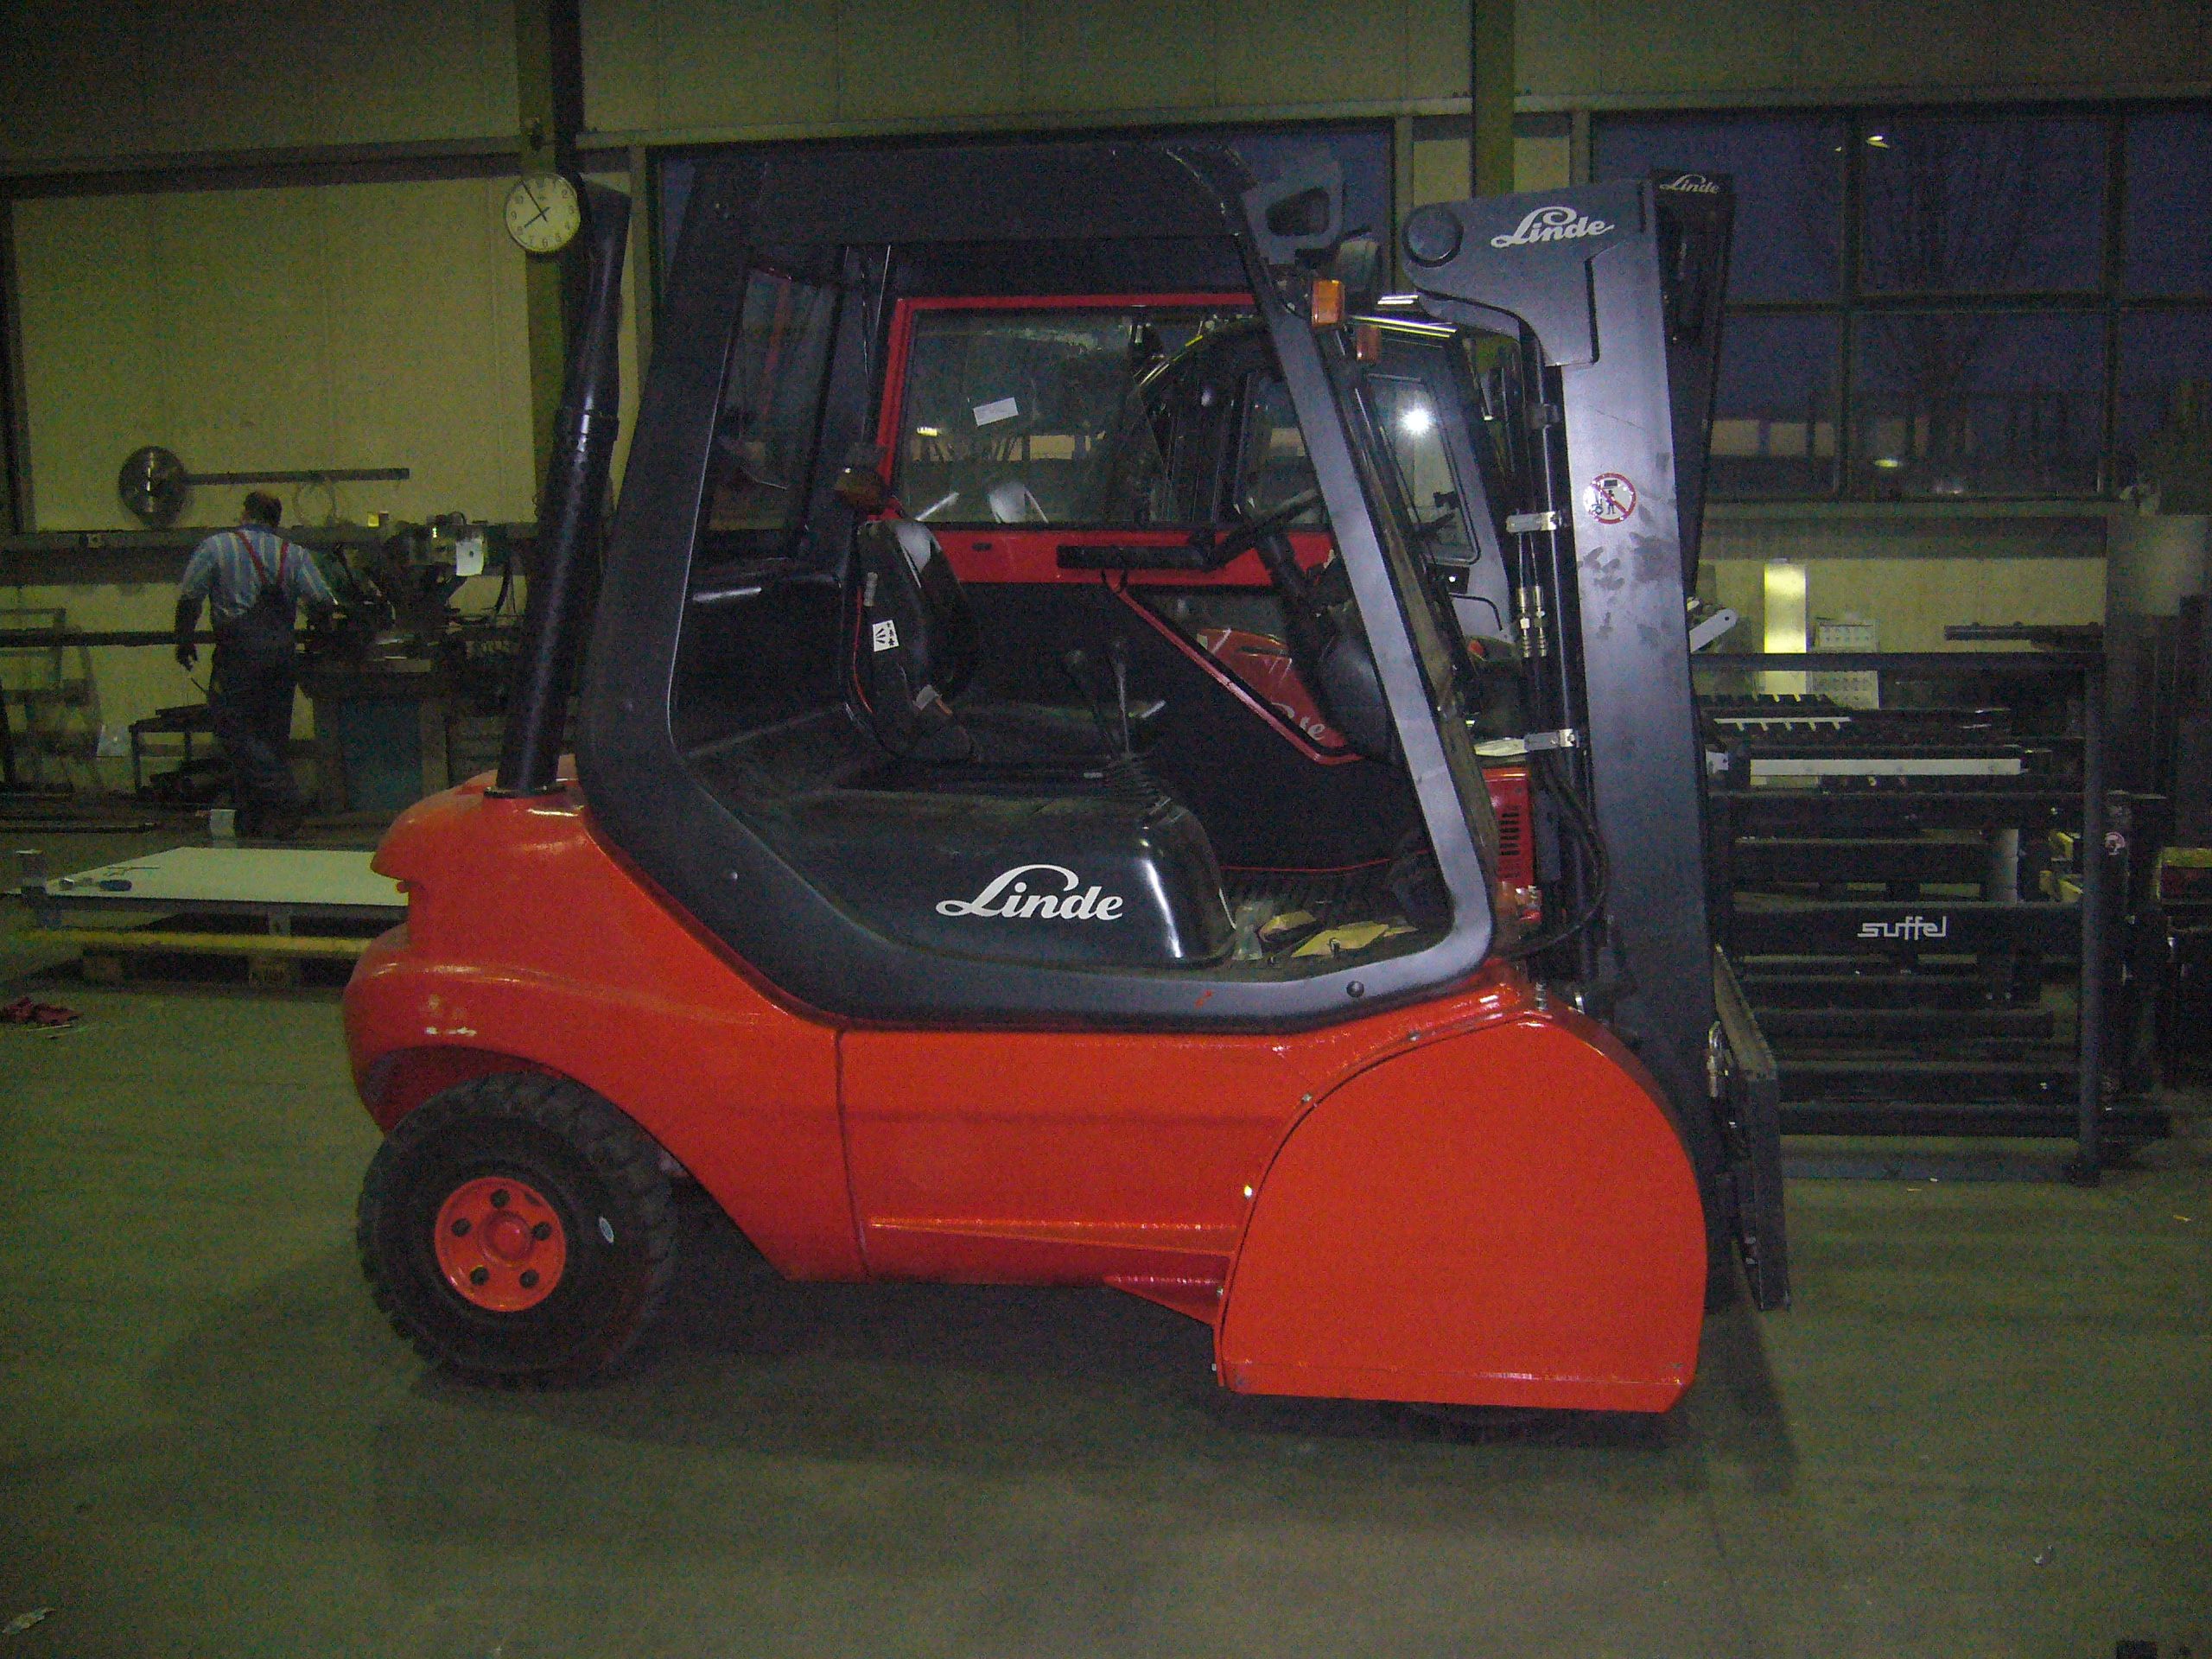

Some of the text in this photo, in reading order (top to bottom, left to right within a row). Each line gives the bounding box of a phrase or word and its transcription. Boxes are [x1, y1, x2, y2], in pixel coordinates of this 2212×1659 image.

[1659, 174, 1720, 194] Linde
[1491, 206, 1616, 249] Linde
[936, 864, 1123, 920] Linde
[1858, 916, 1947, 941] suffel
